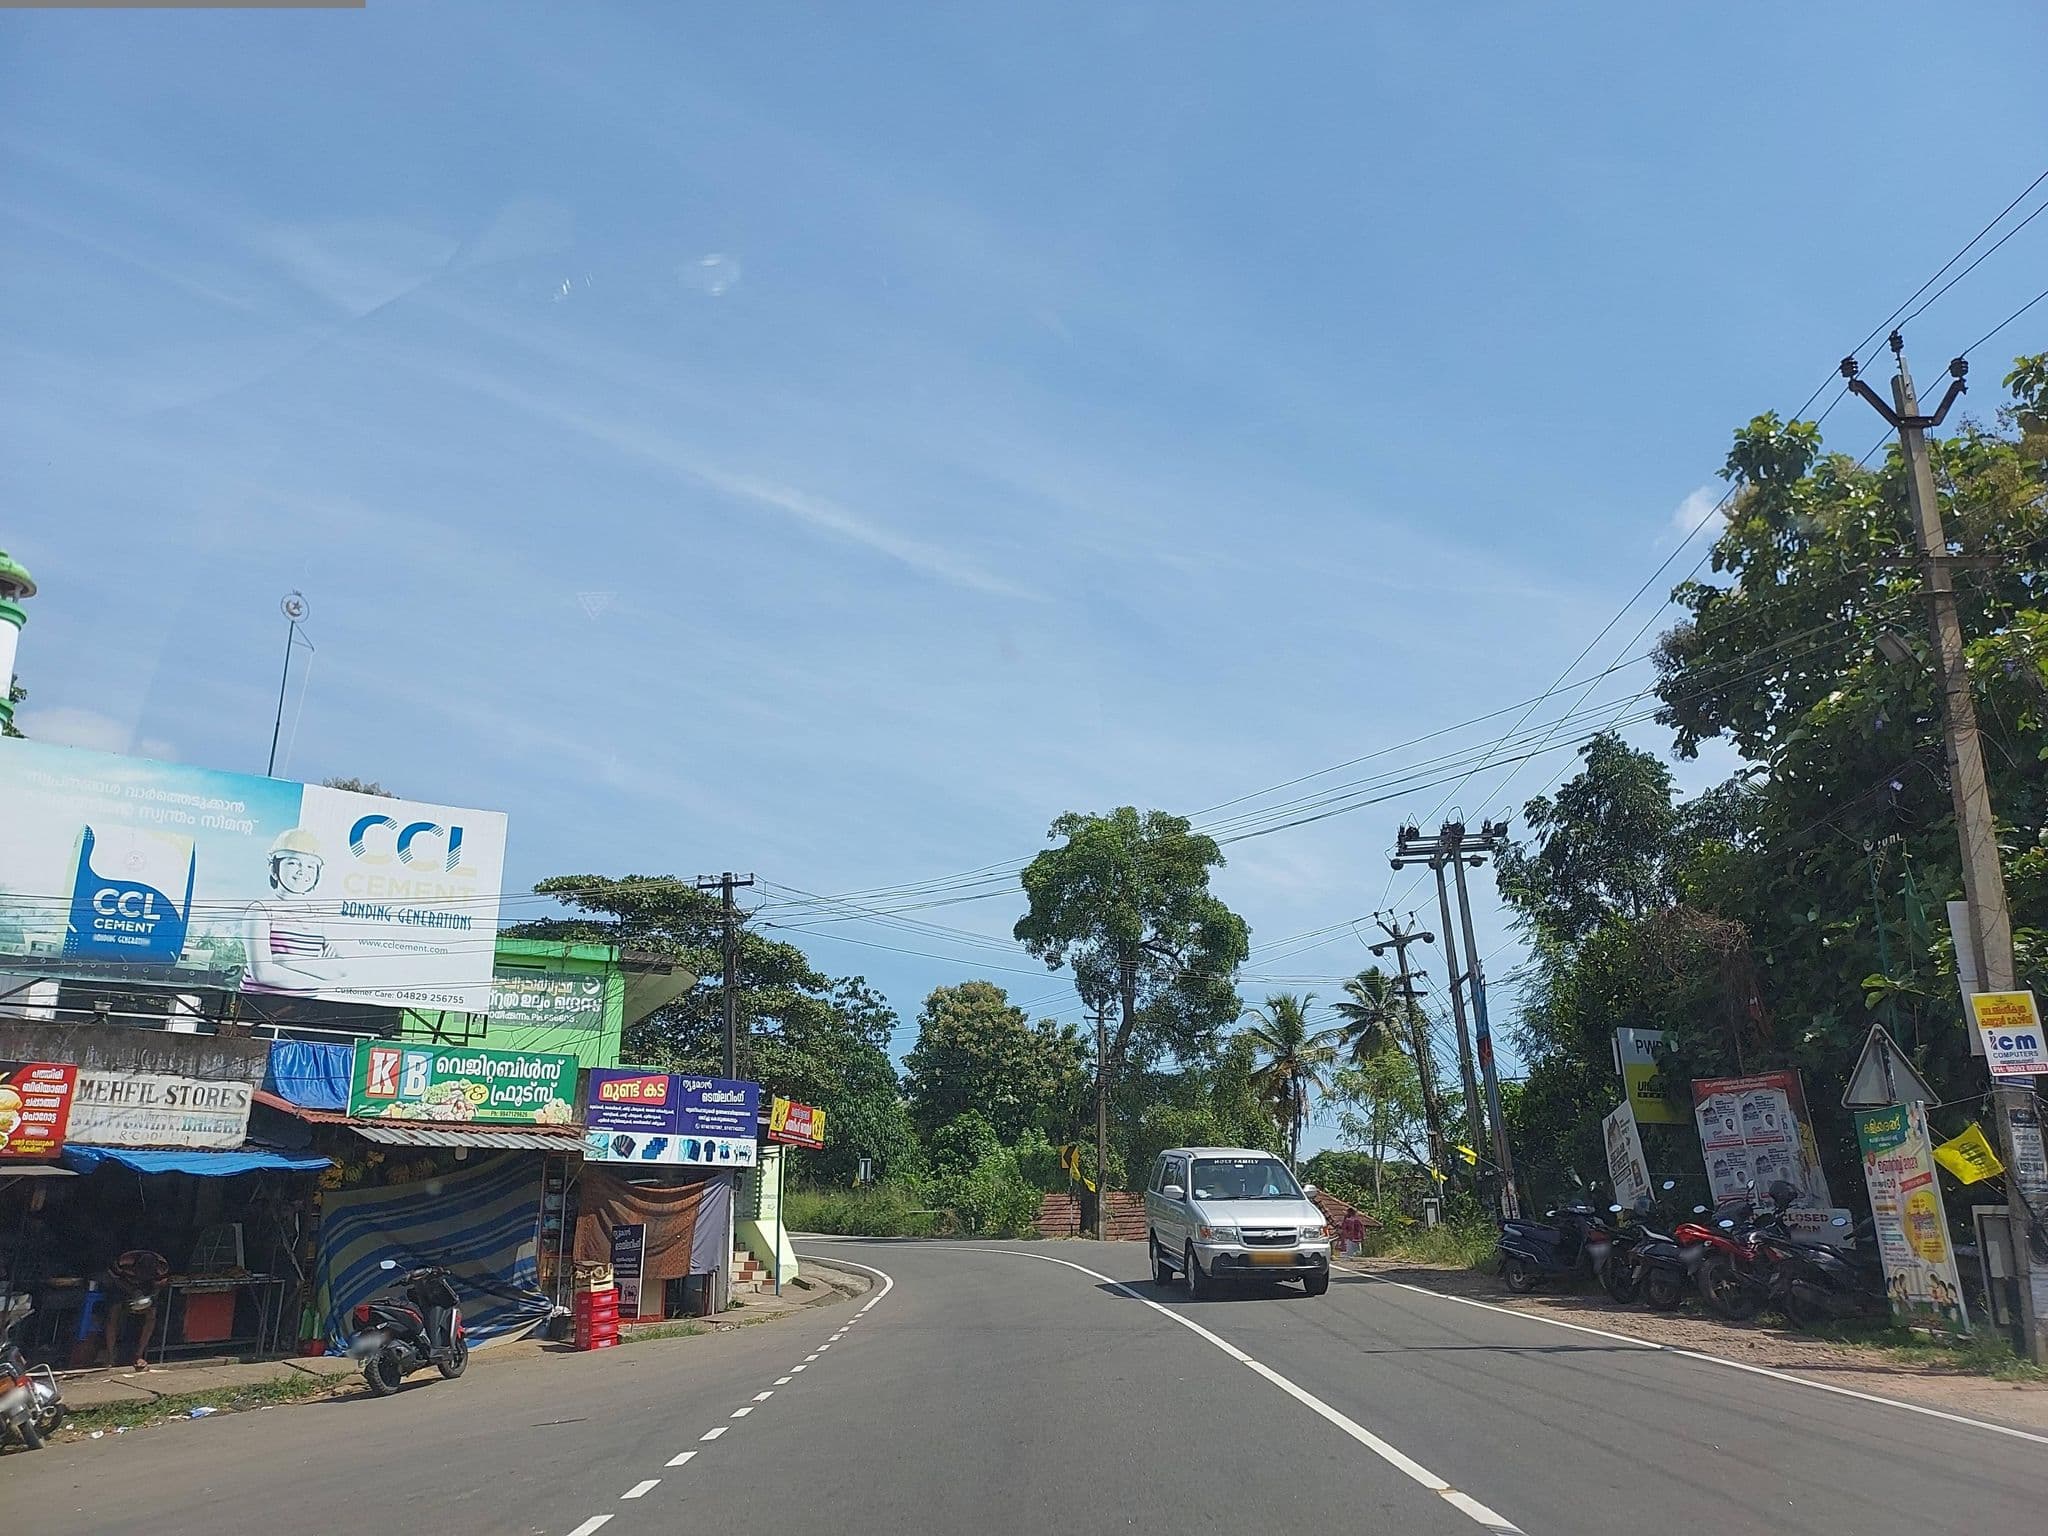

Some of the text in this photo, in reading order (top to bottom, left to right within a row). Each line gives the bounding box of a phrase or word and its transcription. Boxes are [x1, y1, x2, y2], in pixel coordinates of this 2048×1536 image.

[349, 814, 477, 877] CCL
[92, 888, 161, 920] CCL
[94, 918, 156, 934] CEMENT
[341, 900, 472, 931] BONDING GENERATIONS
[358, 938, 448, 955] www.cclcement.com
[374, 989, 395, 999] Care:
[396, 991, 428, 1001] 04829
[430, 993, 464, 1004] 256755
[1992, 1051, 2039, 1059] COMPUTERS
[436, 1053, 565, 1083] വെജിറ്റബിൾസ്
[79, 1079, 248, 1108] MEHFIL STORES
[469, 1085, 486, 1101] &
[602, 1080, 666, 1101] മുണ്ട് കട
